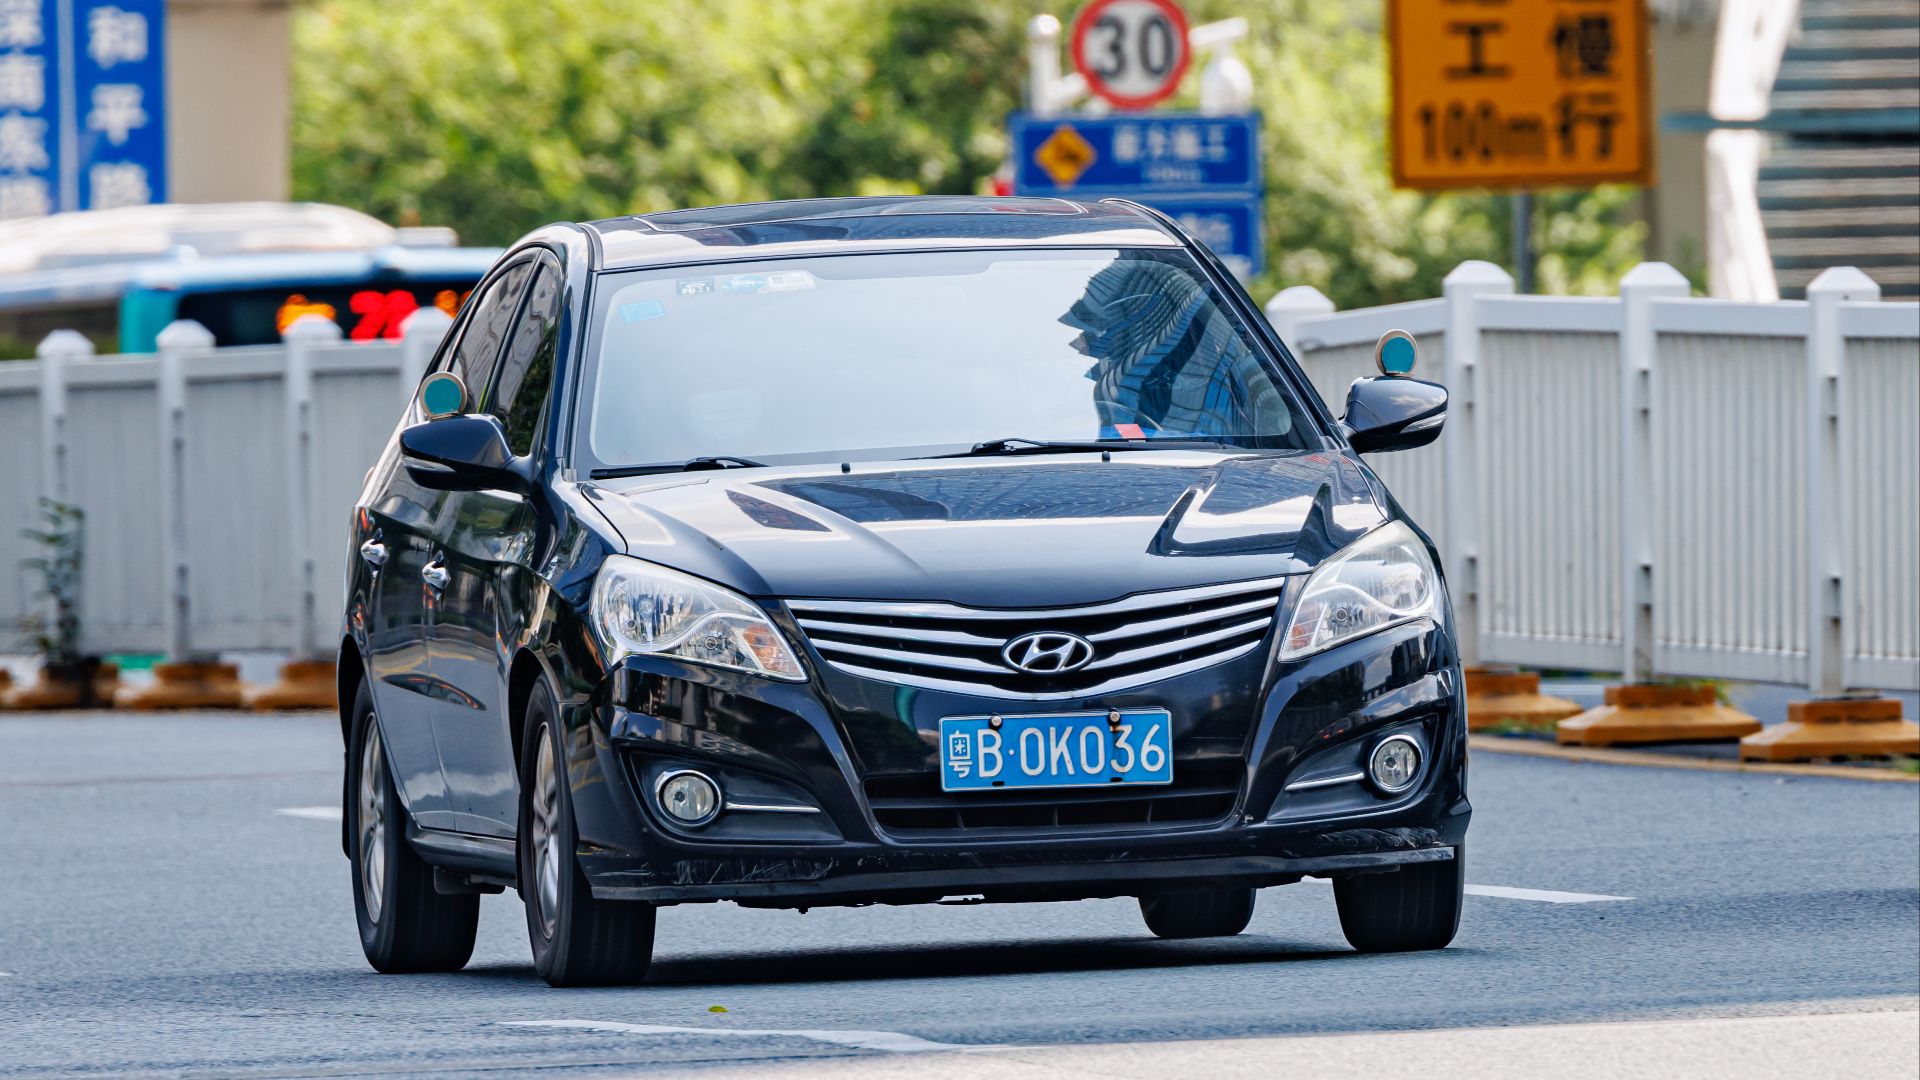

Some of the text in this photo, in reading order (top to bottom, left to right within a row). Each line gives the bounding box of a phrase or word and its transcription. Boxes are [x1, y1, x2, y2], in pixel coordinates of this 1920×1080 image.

[1093, 14, 1175, 79] 30
[87, 5, 151, 209] 和平路
[1416, 101, 1547, 163] 100m
